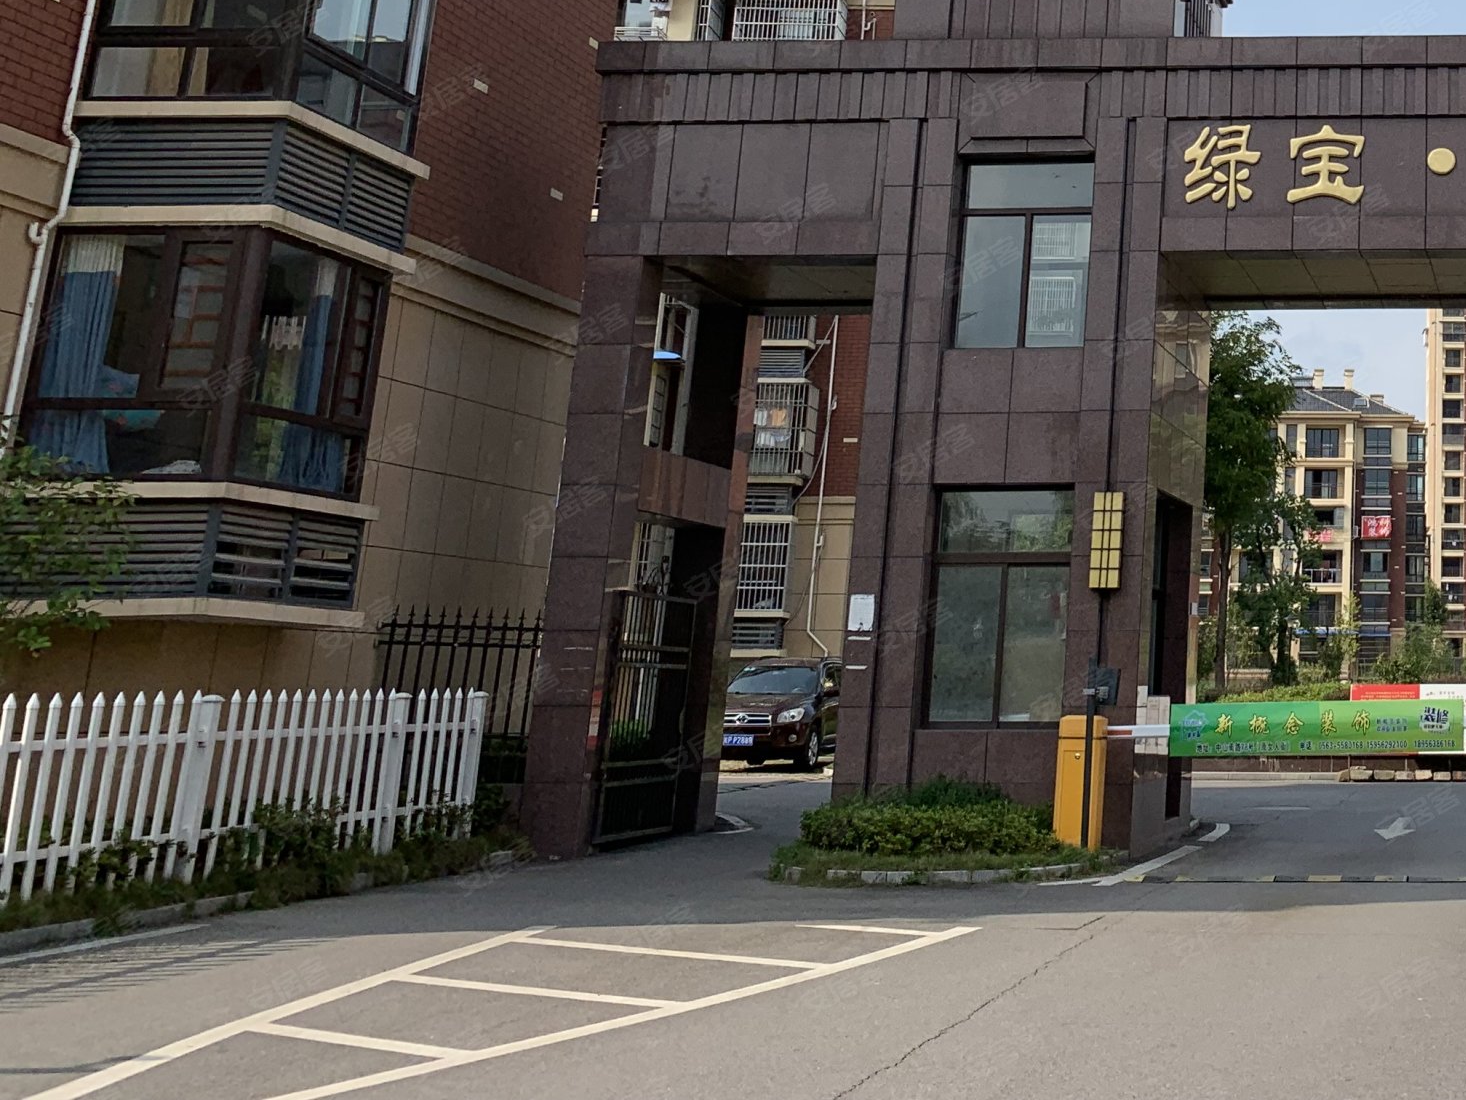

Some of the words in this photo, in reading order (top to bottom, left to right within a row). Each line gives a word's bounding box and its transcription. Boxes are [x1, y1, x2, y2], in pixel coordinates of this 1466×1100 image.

[1214, 708, 1370, 737] 新概念装饰
